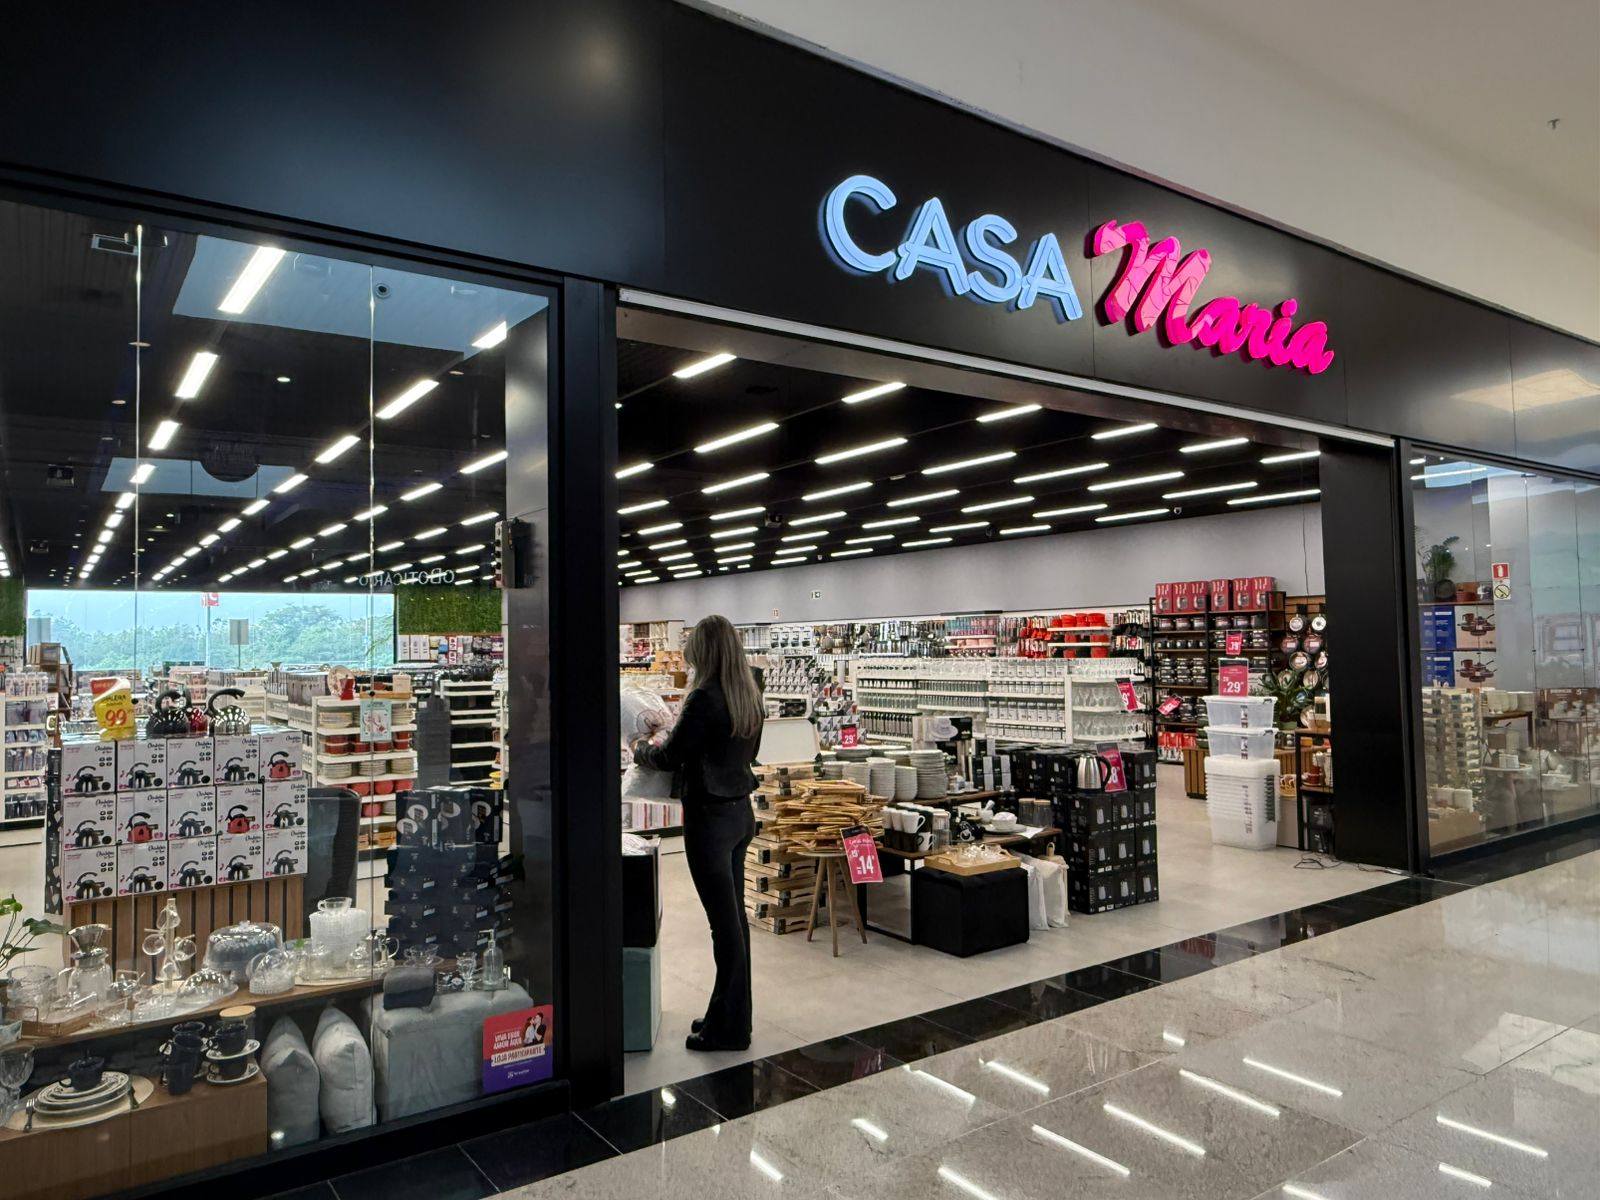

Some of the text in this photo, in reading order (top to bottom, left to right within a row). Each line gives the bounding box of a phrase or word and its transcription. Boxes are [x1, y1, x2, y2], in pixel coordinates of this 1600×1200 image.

[820, 173, 1335, 374] CASA Maria
[1227, 681, 1241, 693] 29
[105, 708, 128, 727] 99
[859, 855, 874, 875] 14
[494, 1053, 508, 1064] LOJA
